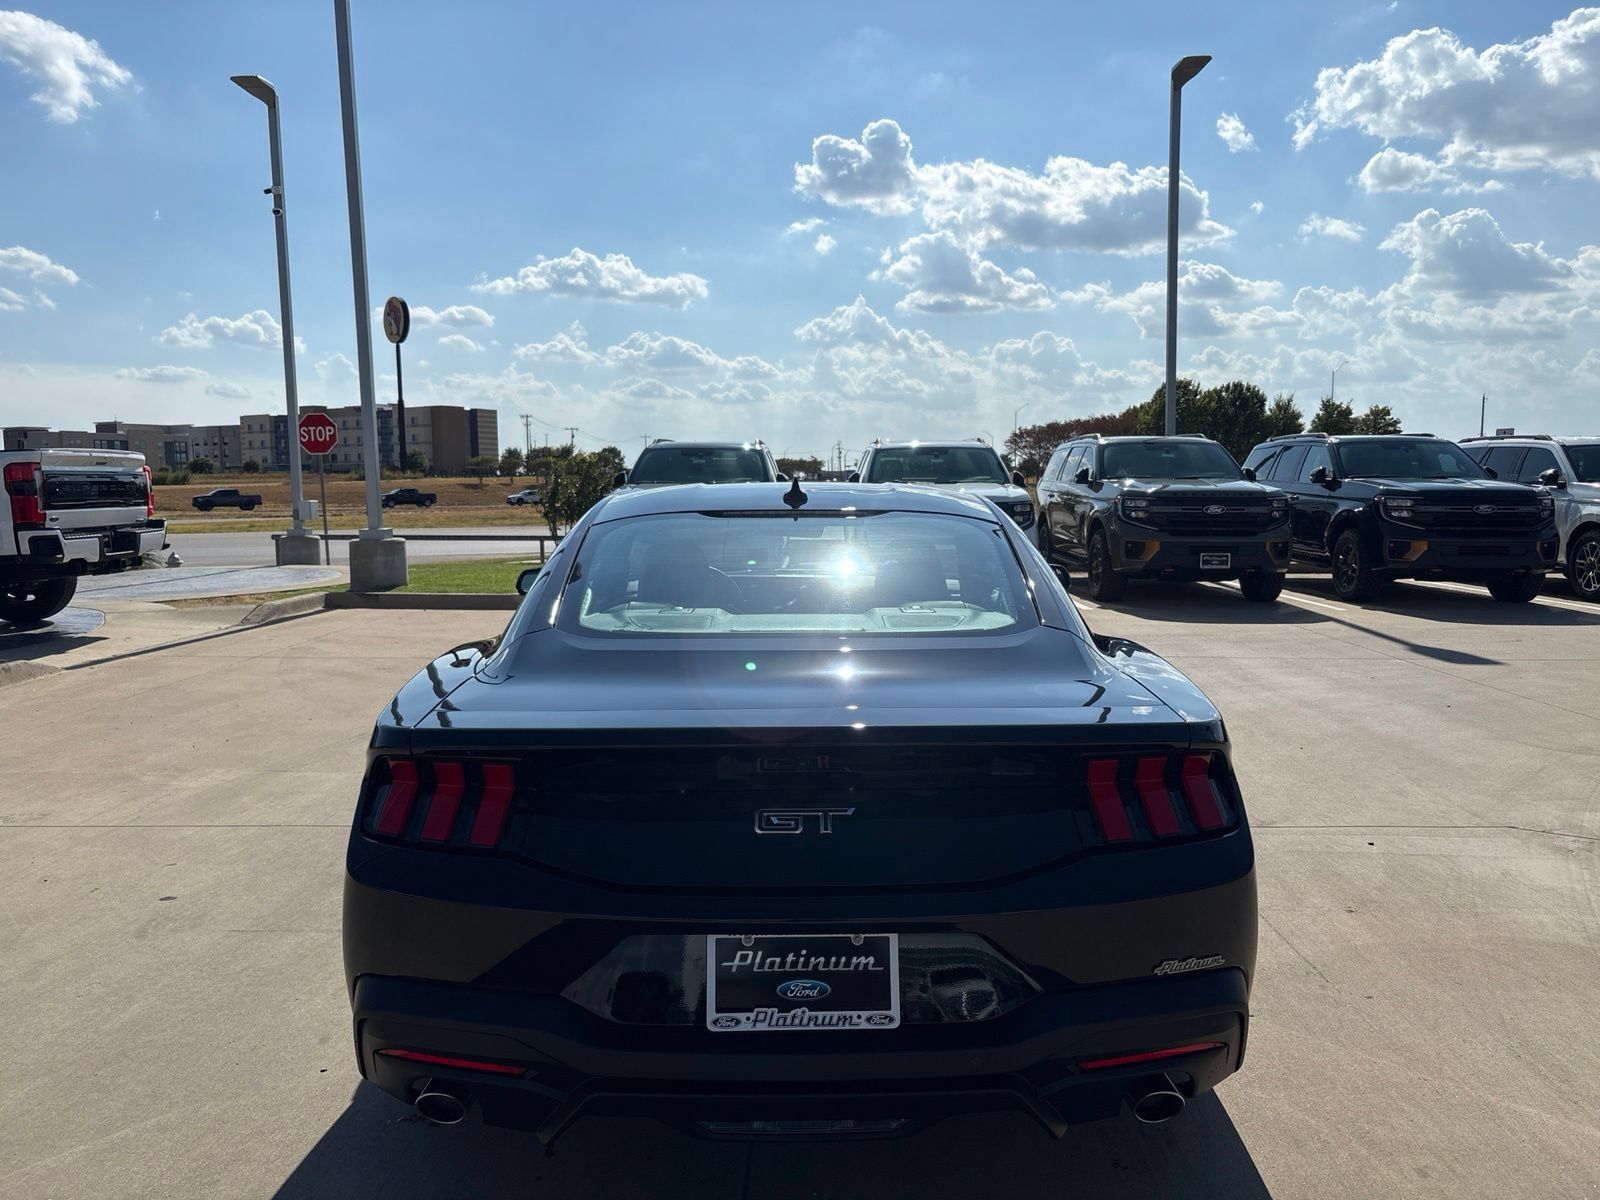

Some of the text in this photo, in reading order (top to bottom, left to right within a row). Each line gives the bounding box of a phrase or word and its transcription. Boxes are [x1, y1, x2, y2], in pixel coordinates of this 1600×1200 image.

[300, 426, 335, 442] STOP
[754, 807, 856, 834] GT
[720, 950, 884, 973] Platinum
[1154, 955, 1225, 975] Platinum
[787, 982, 819, 998] Ford
[716, 1008, 891, 1028] Ford Platinum Ford
